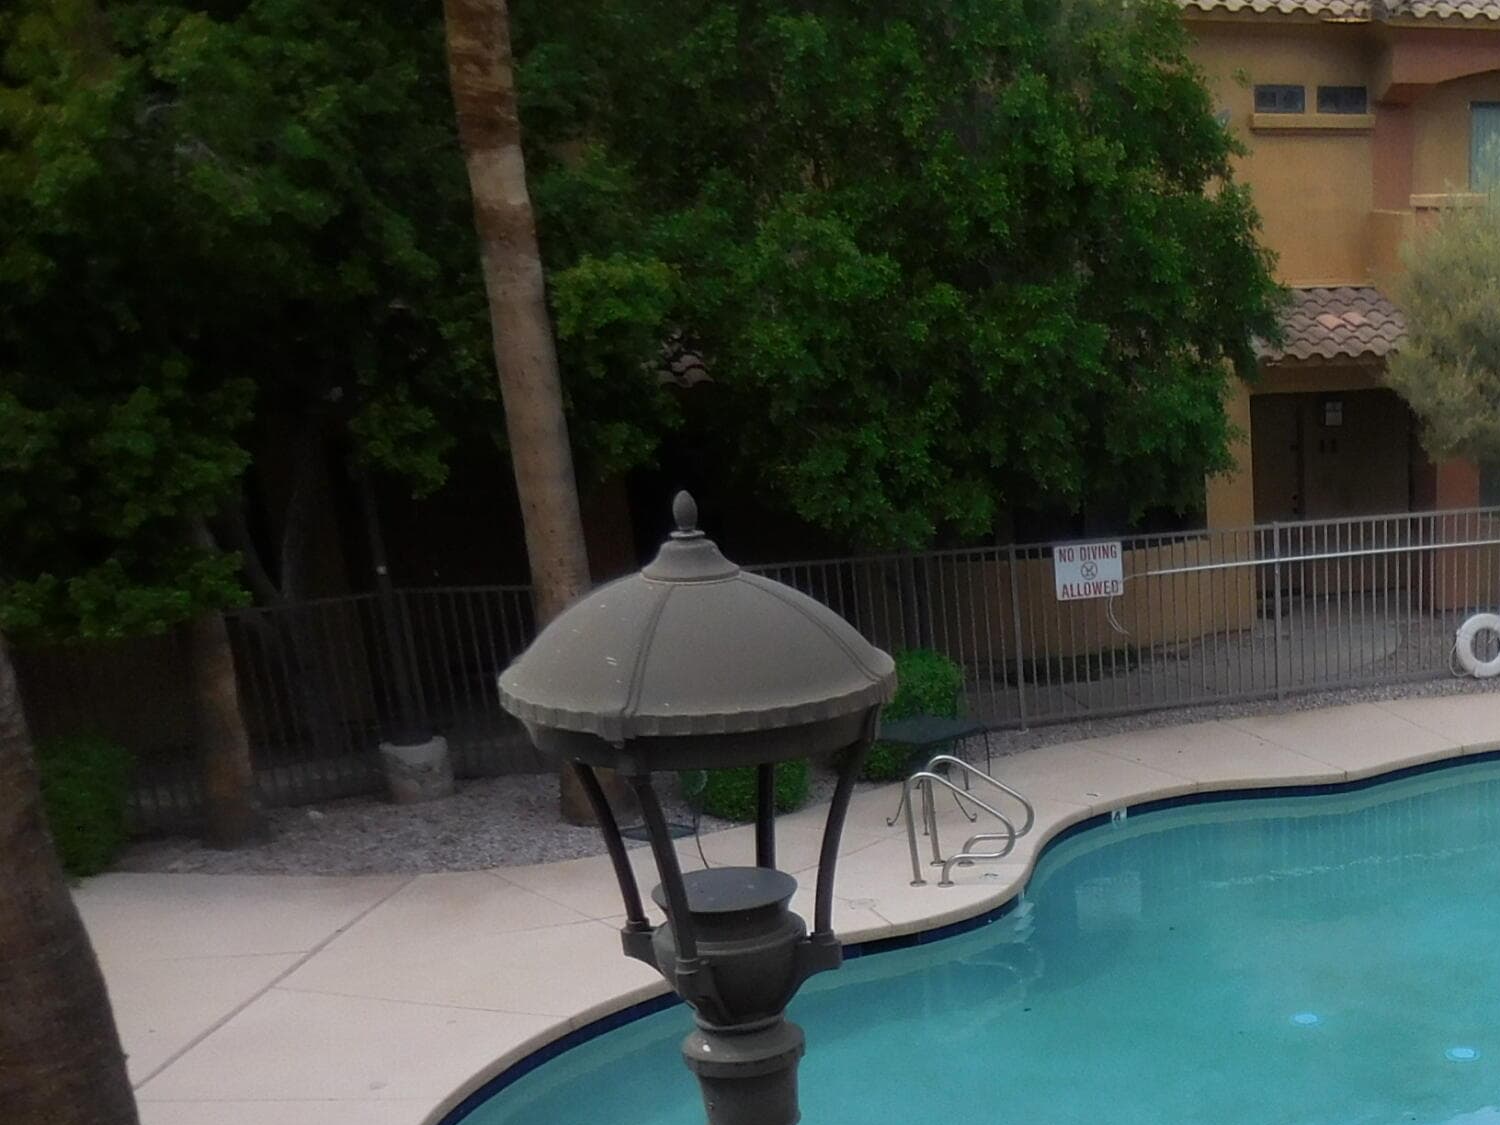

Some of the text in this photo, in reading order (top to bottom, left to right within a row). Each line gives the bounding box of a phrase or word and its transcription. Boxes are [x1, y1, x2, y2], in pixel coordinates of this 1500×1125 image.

[1059, 544, 1117, 563] NO DIVING
[1062, 580, 1119, 598] ALLOWED
